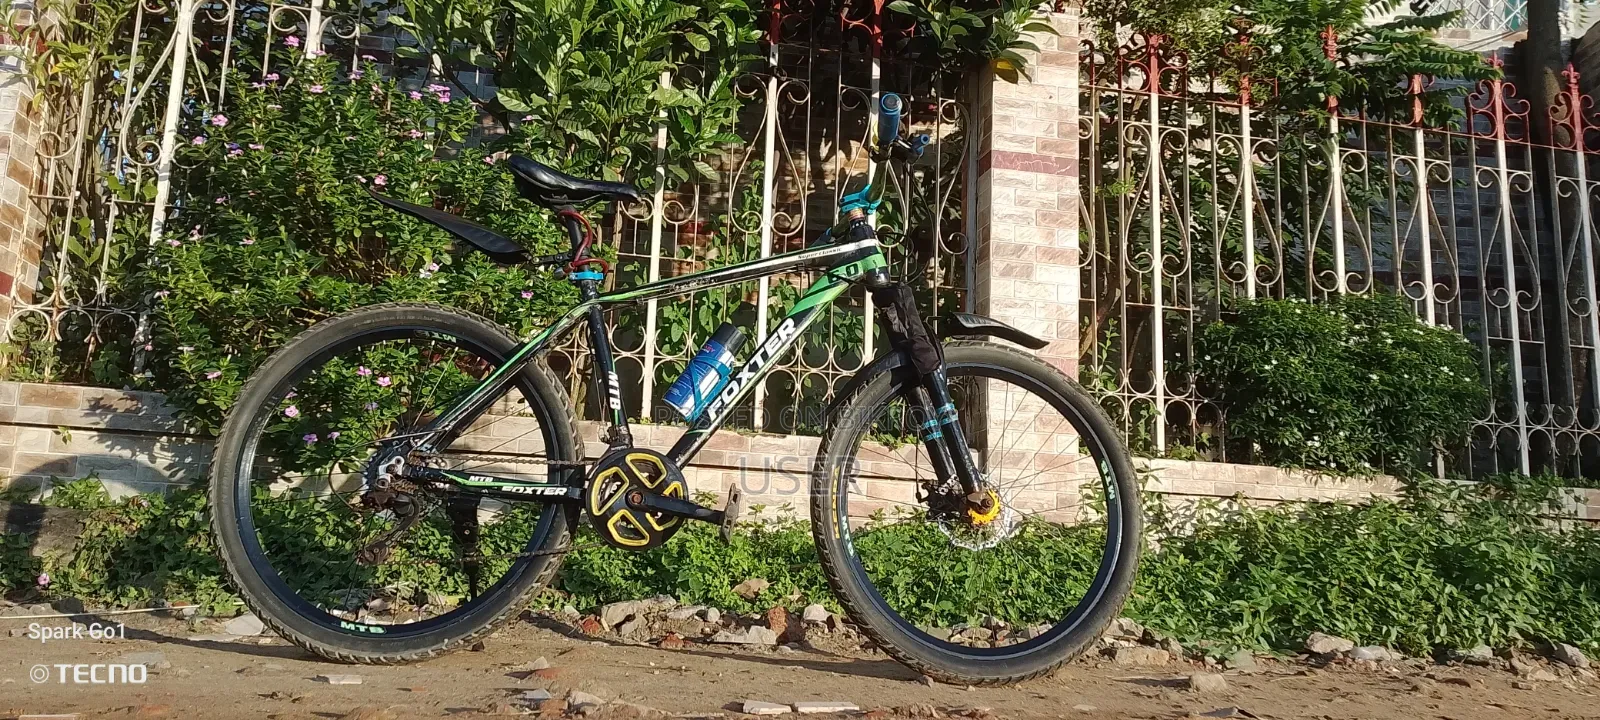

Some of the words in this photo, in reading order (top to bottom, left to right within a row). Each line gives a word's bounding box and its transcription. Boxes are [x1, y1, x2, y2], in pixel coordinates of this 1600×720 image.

[707, 317, 797, 422] FOXTER
[608, 370, 621, 410] MTB
[468, 475, 494, 483] MTB
[501, 485, 568, 496] FOXTER
[1100, 459, 1116, 500] MTB
[841, 515, 855, 557] MTB
[340, 620, 385, 634] MTB
